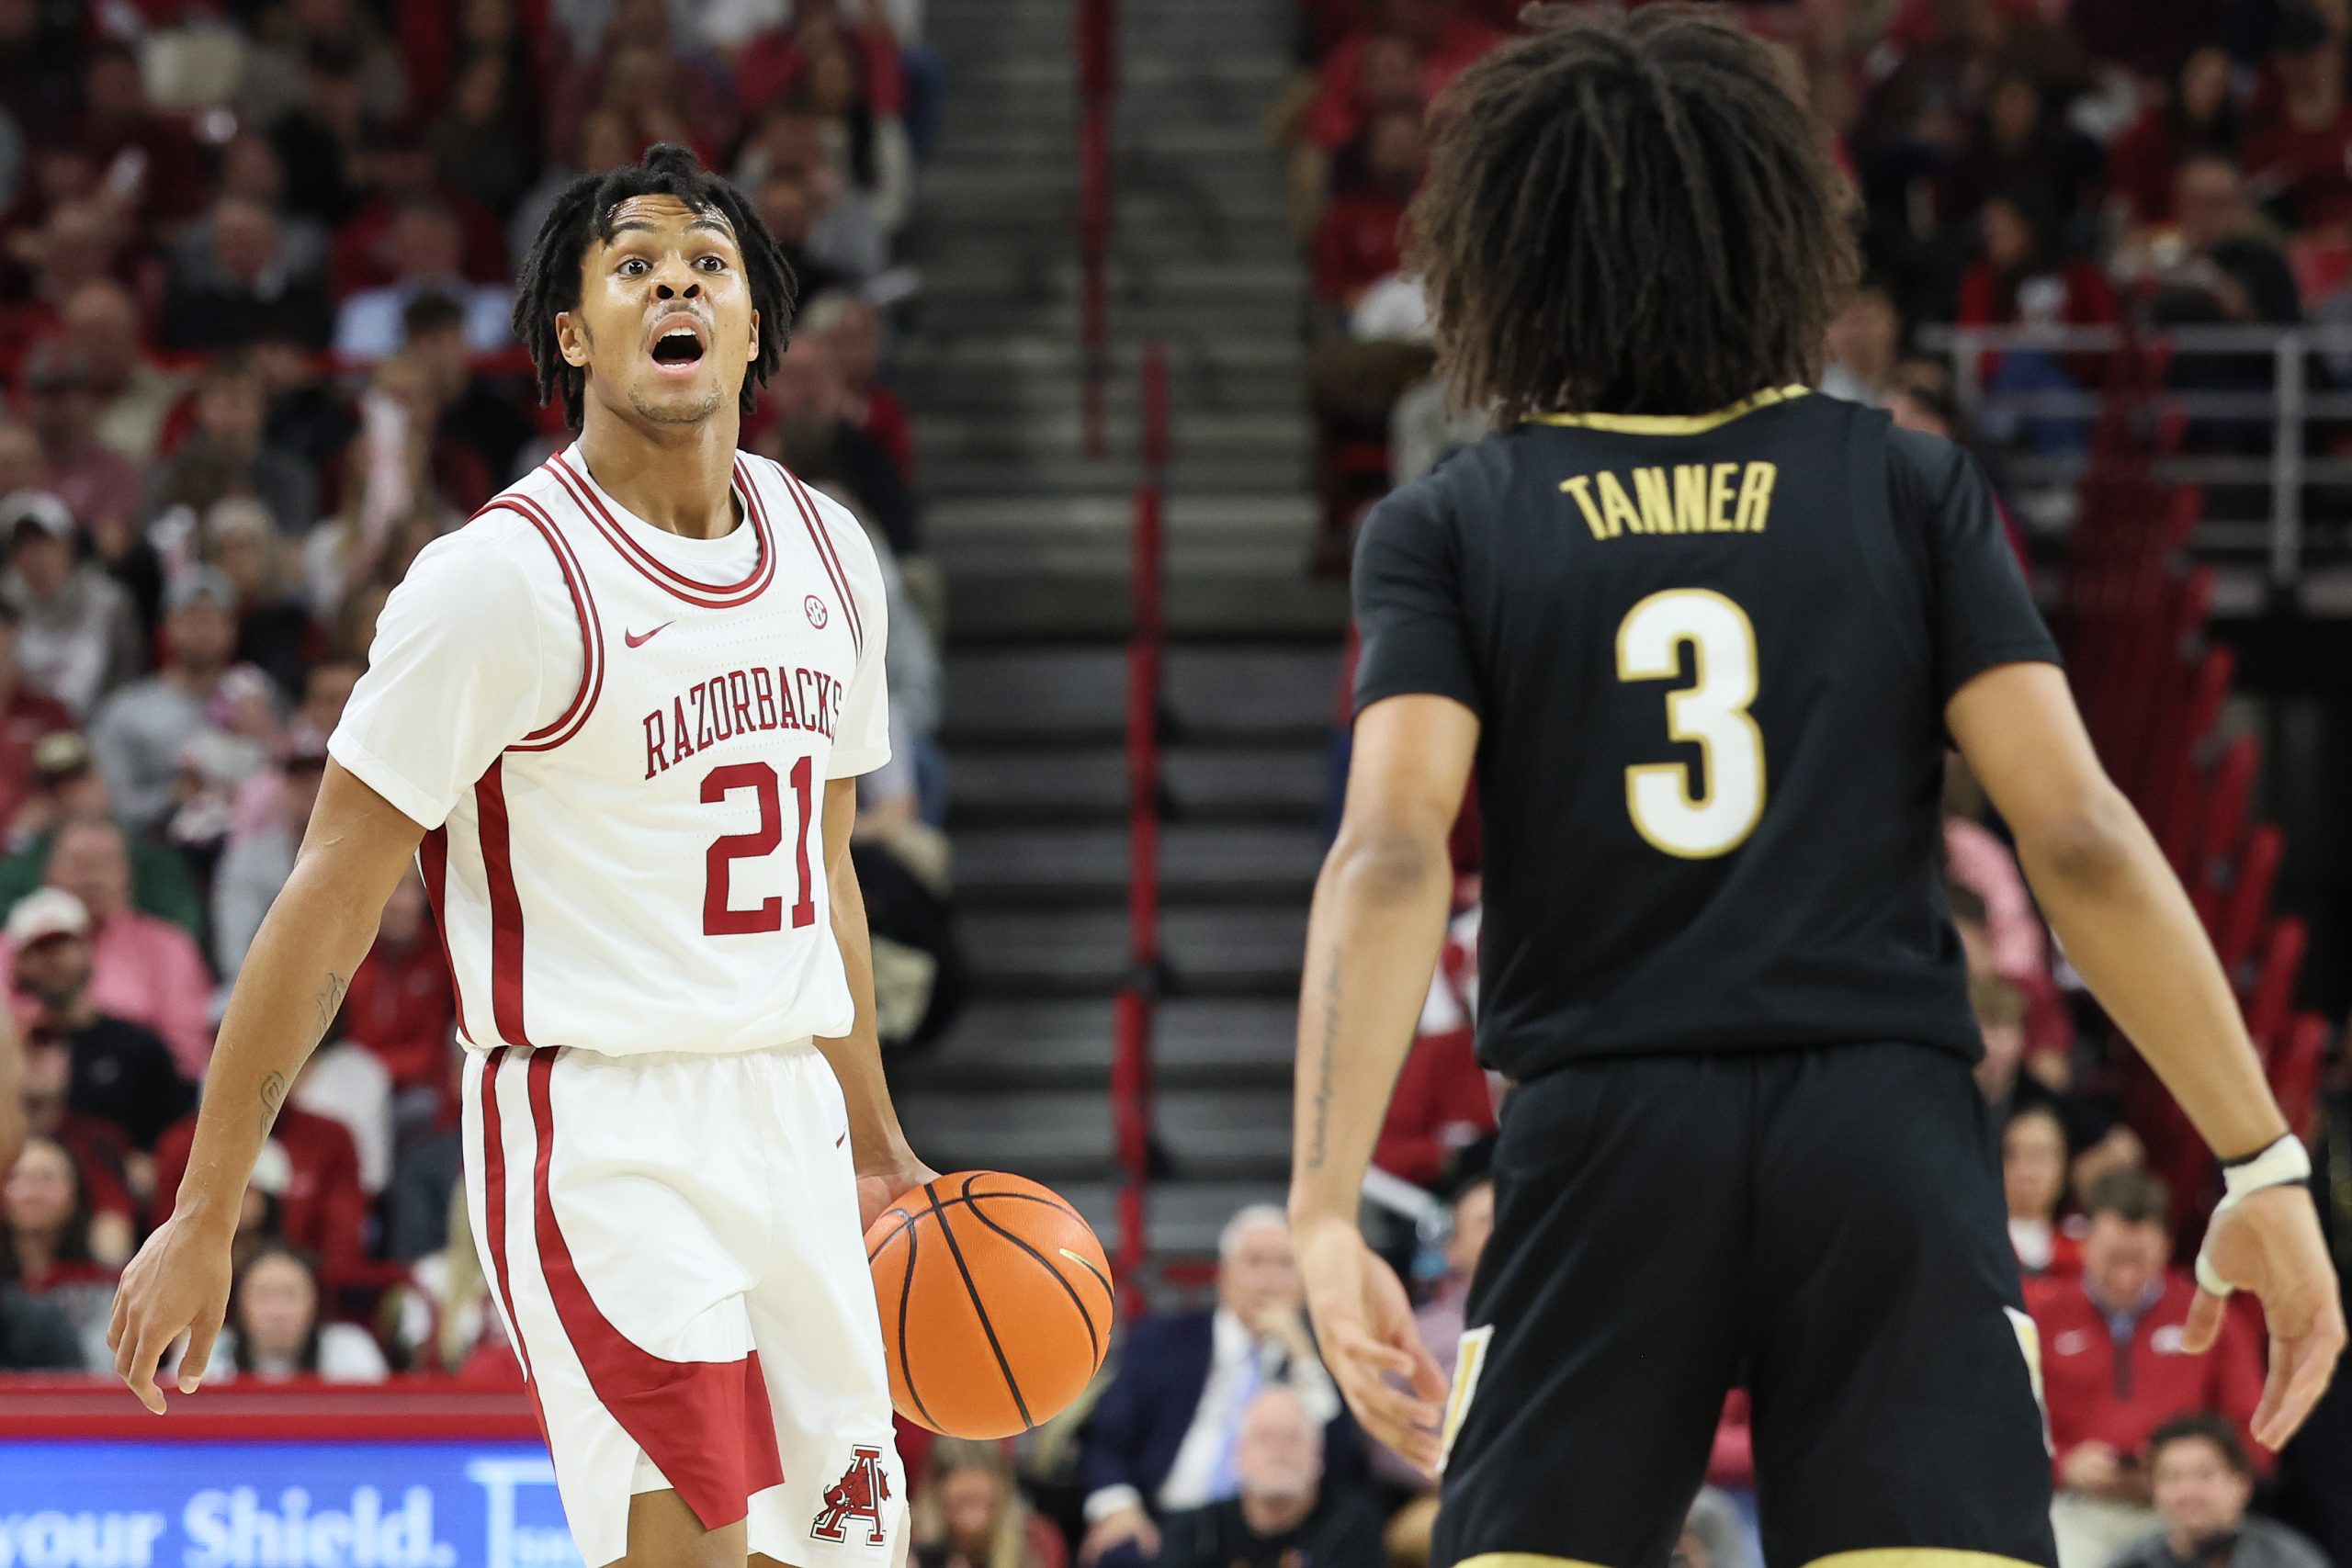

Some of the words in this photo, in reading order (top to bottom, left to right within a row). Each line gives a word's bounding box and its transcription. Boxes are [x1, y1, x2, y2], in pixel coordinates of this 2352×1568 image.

[1559, 461, 1777, 539] TANNER
[643, 666, 842, 780] RAZORBACKS
[1614, 587, 1767, 860] 3
[700, 755, 815, 935] 21
[184, 1485, 457, 1568] Shield.
